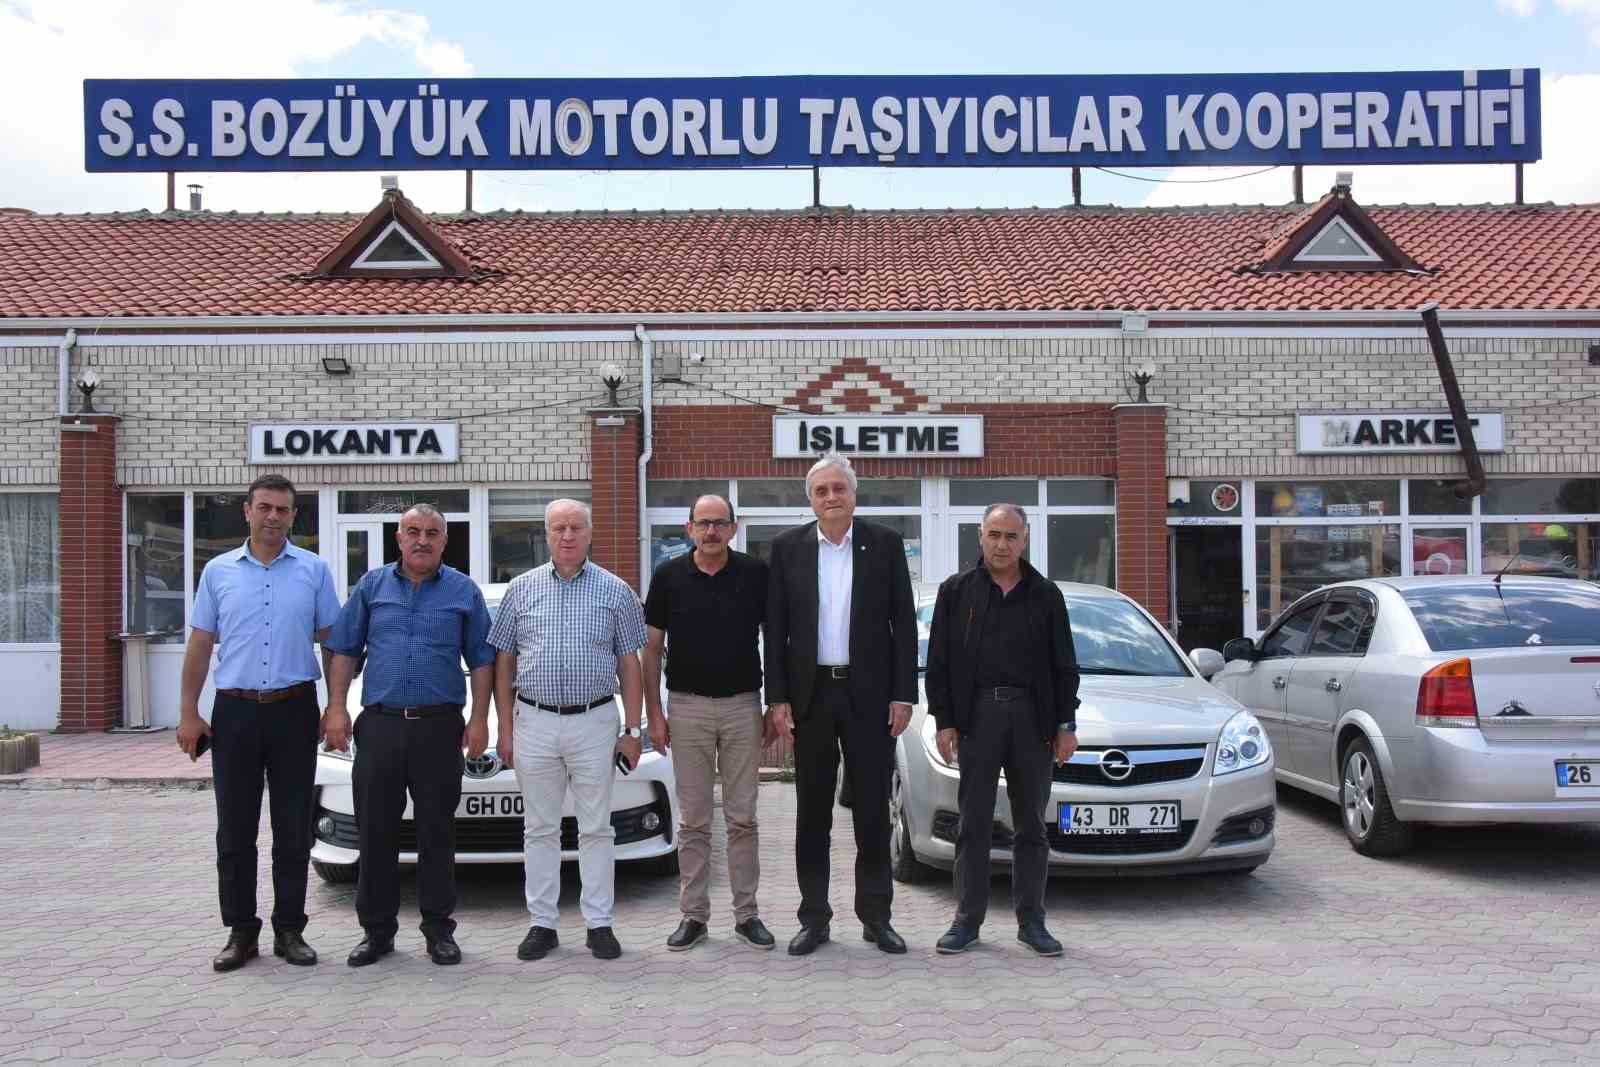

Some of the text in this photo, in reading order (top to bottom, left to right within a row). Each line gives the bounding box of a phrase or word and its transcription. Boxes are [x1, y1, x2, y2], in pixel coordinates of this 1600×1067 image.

[98, 68, 1525, 162] S.S. BOZÜYÜK MOTORLU TAŞIYICILAR KOOPERATİFİ
[263, 429, 442, 455] LOKANTA
[1568, 765, 1592, 784] 26
[466, 796, 495, 815] GH
[1072, 807, 1093, 826] 43
[1109, 807, 1130, 826] DR
[1150, 806, 1176, 826] 271
